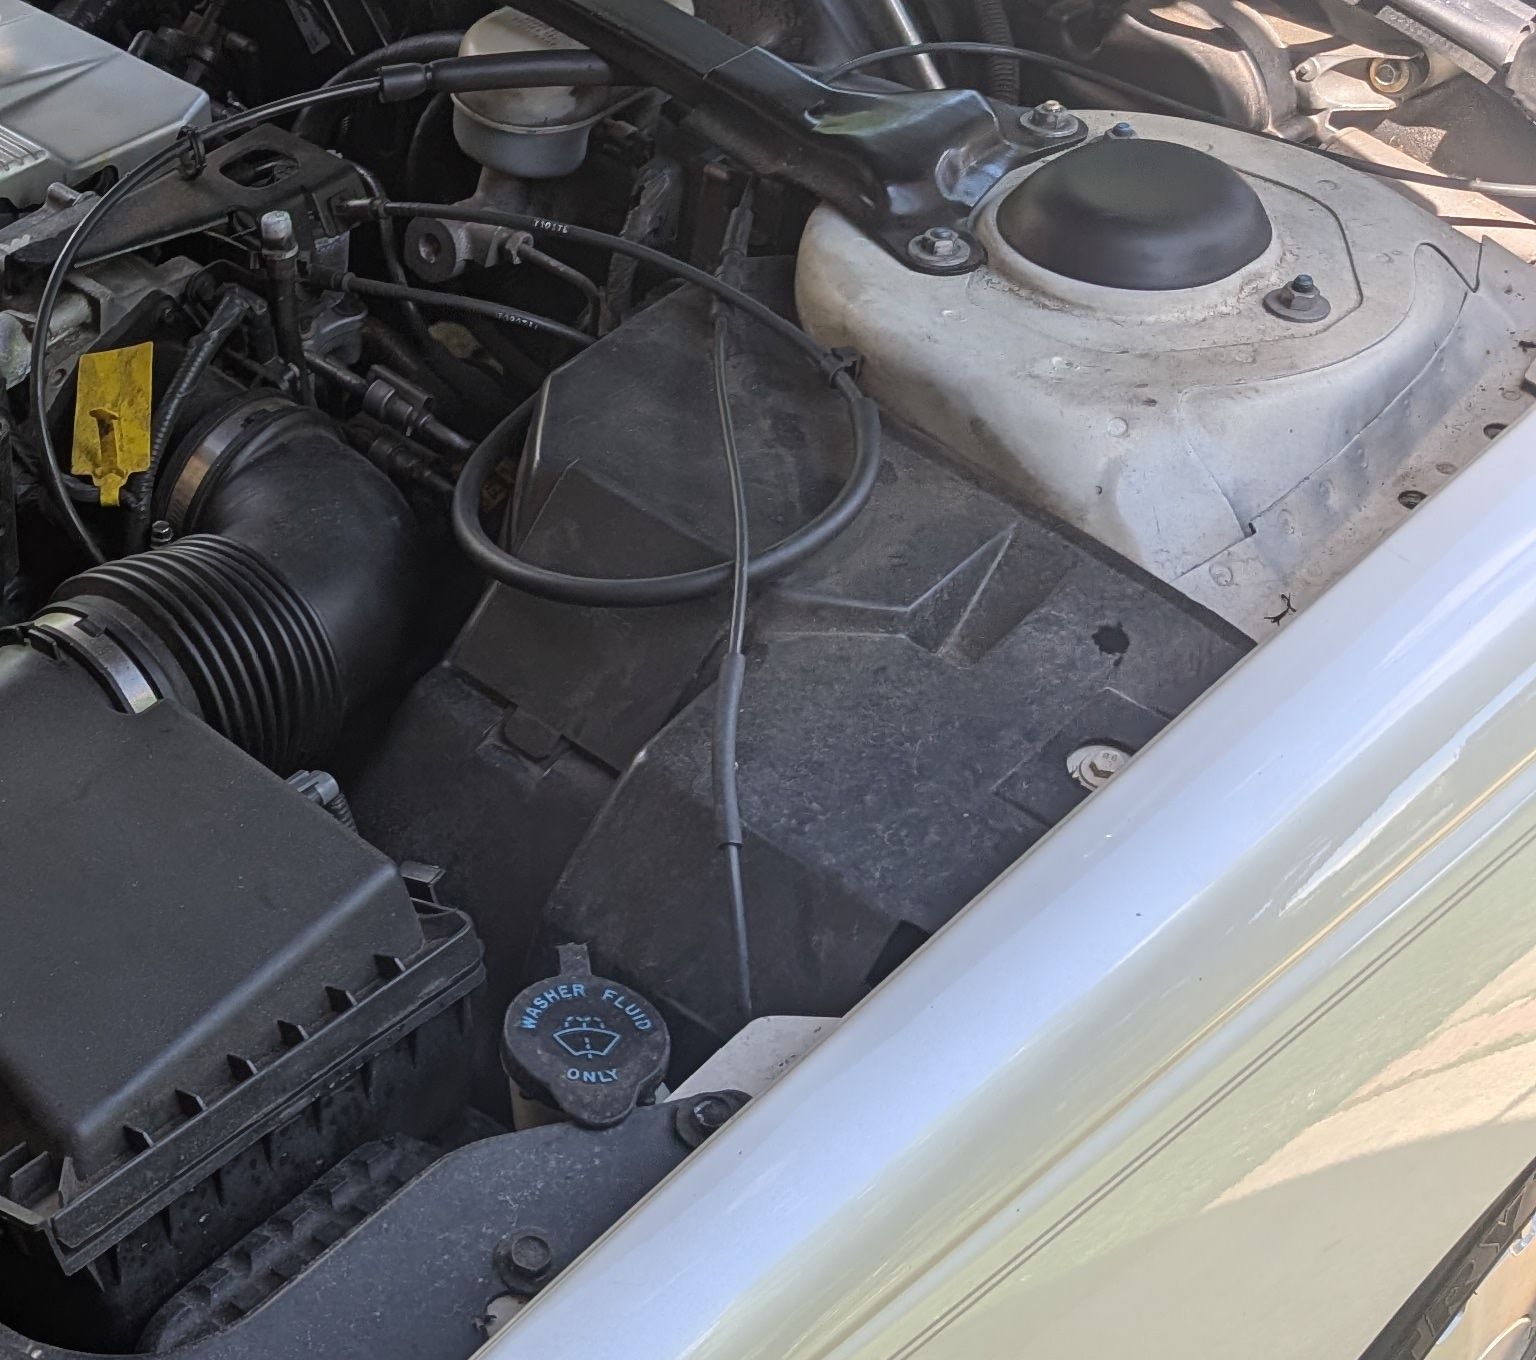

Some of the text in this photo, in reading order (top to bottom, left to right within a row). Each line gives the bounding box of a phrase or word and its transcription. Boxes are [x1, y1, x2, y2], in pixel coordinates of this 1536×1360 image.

[520, 984, 652, 1030] WASHER FLUID
[567, 1068, 617, 1082] ONLY
